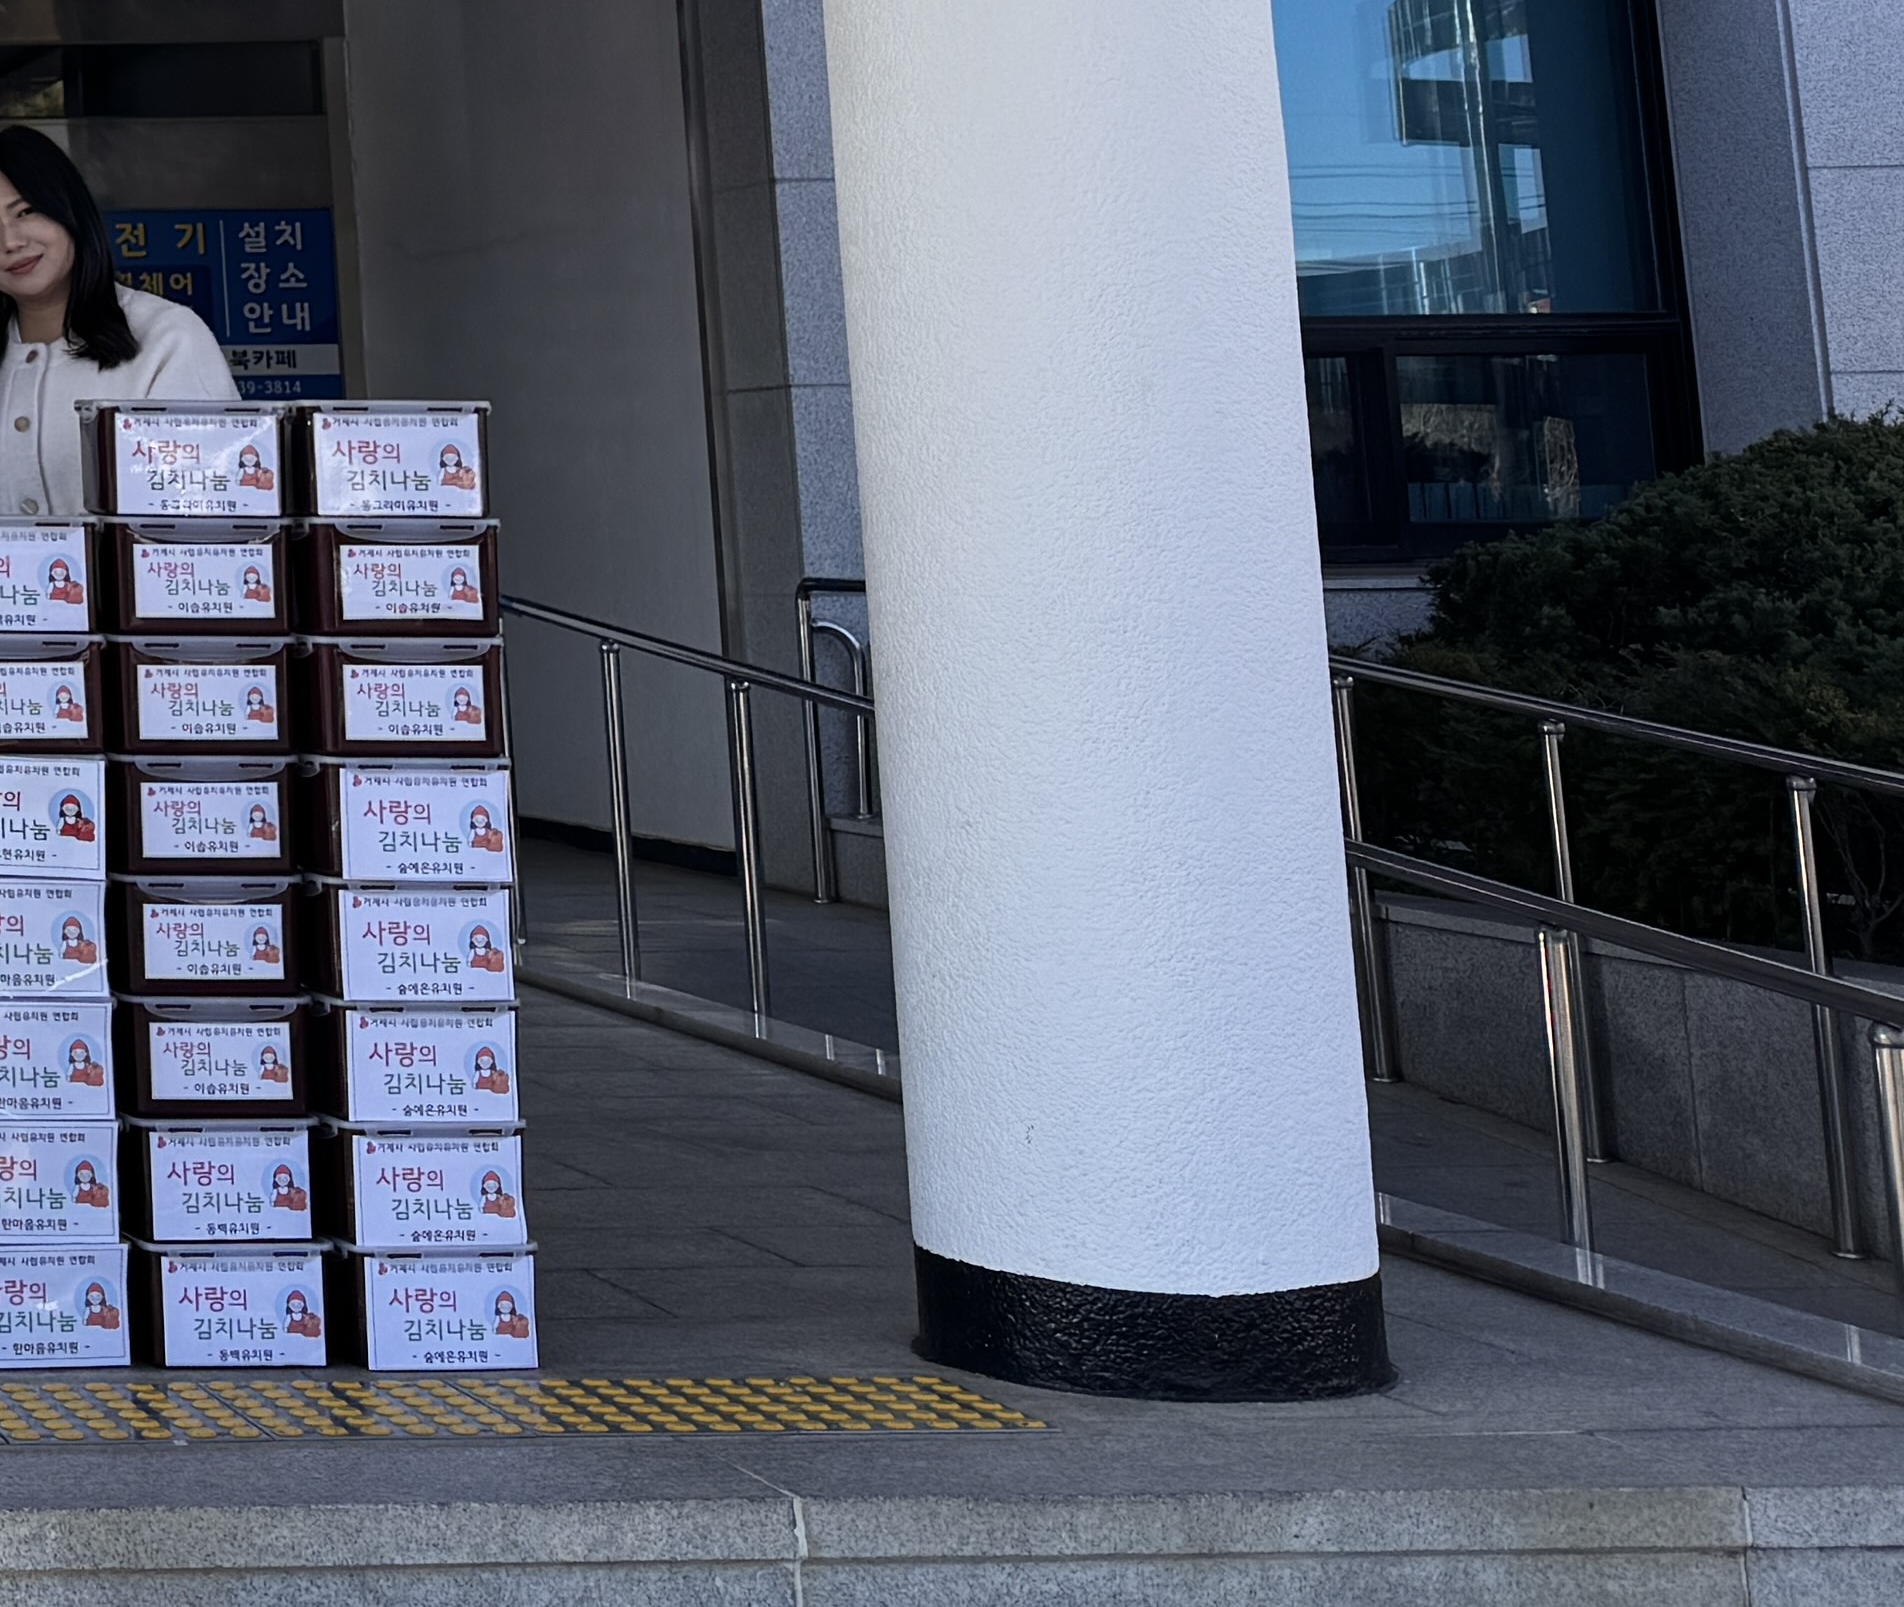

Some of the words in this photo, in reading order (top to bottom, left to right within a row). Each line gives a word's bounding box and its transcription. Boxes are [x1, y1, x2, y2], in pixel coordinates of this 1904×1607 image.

[239, 221, 302, 252] 설치
[241, 262, 308, 294] 장소
[243, 302, 311, 333] 안내
[228, 350, 296, 370] 북카페
[353, 563, 401, 580] 사랑의
[372, 580, 438, 597] 김치나눔
[369, 1041, 436, 1068] 사랑의
[384, 1069, 469, 1096] 김치나눔
[178, 1286, 247, 1312] 사랑의
[389, 1287, 456, 1314] 사랑의
[194, 1317, 278, 1341] 김치나눔
[404, 1318, 487, 1342] 김치나눔
